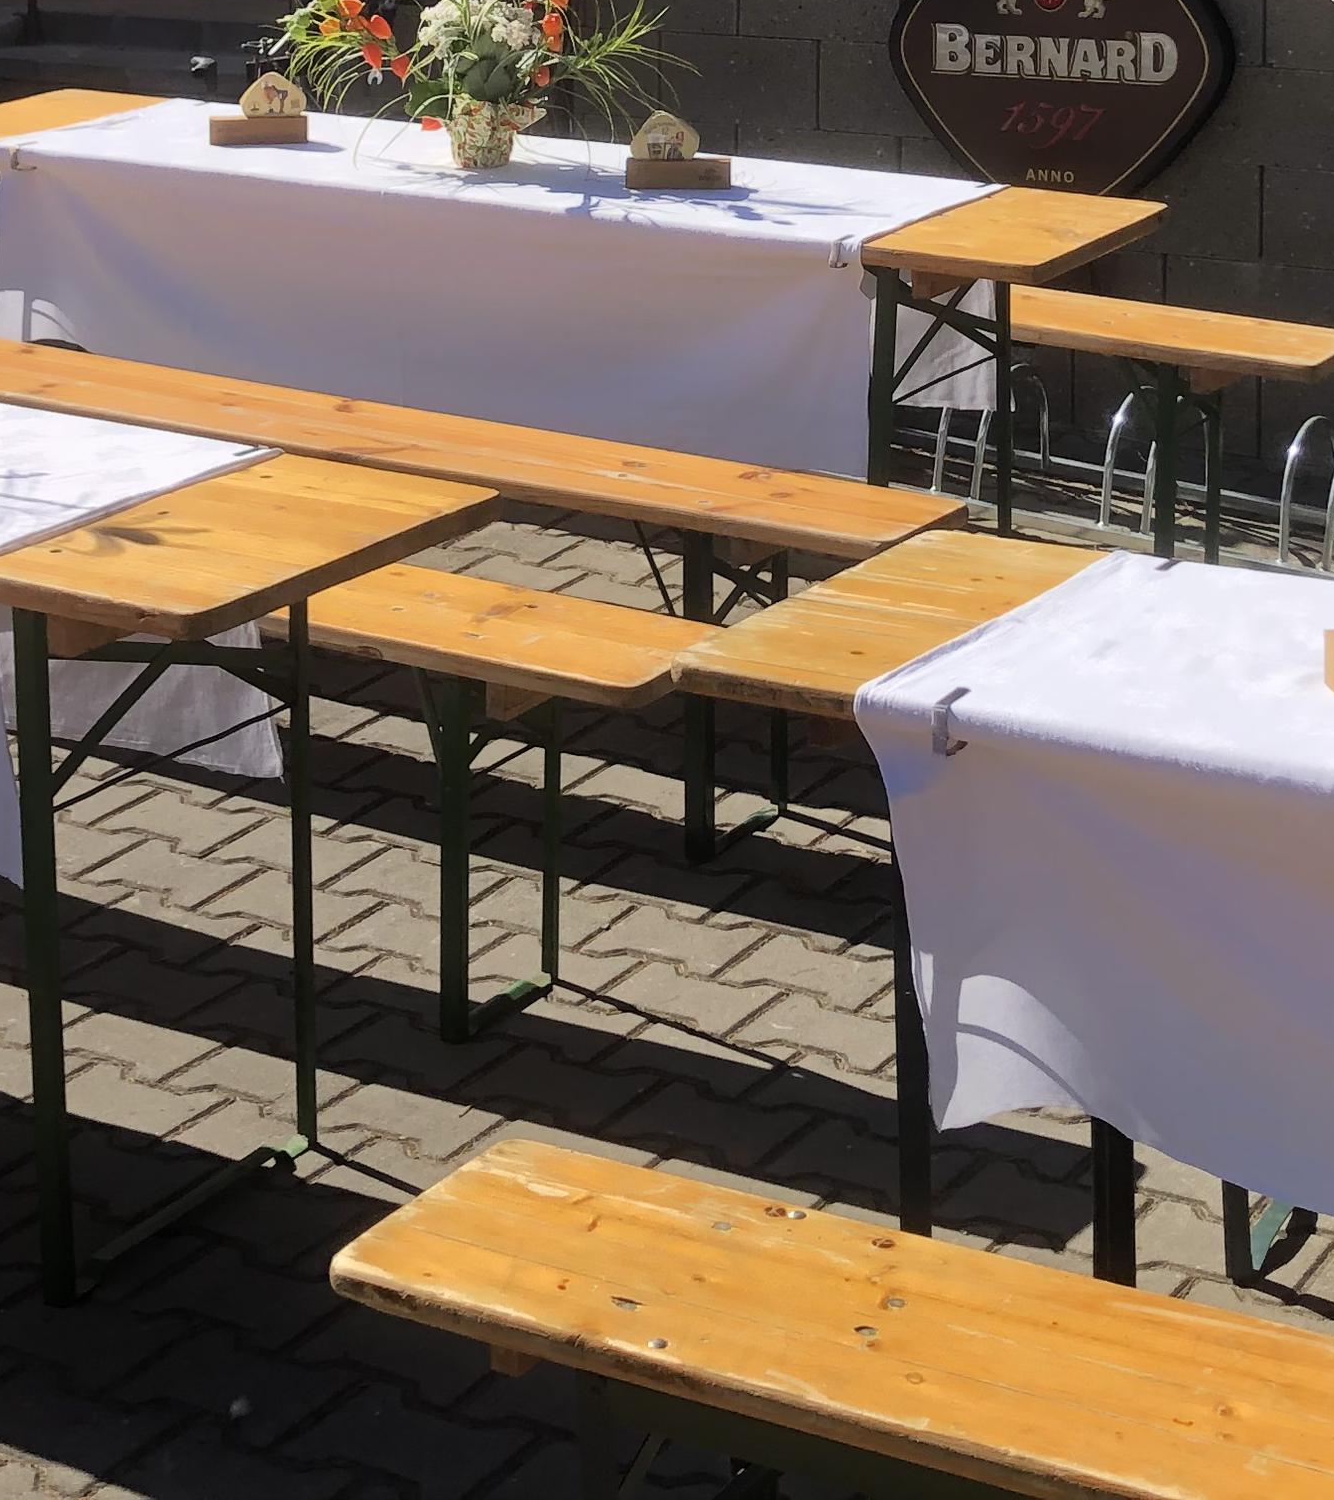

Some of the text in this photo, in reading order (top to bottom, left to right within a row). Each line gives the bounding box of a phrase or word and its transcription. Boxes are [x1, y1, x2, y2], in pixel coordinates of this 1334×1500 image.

[931, 22, 1178, 85] BERNARD
[1000, 103, 1106, 149] 1597
[1025, 167, 1075, 184] ANNO
